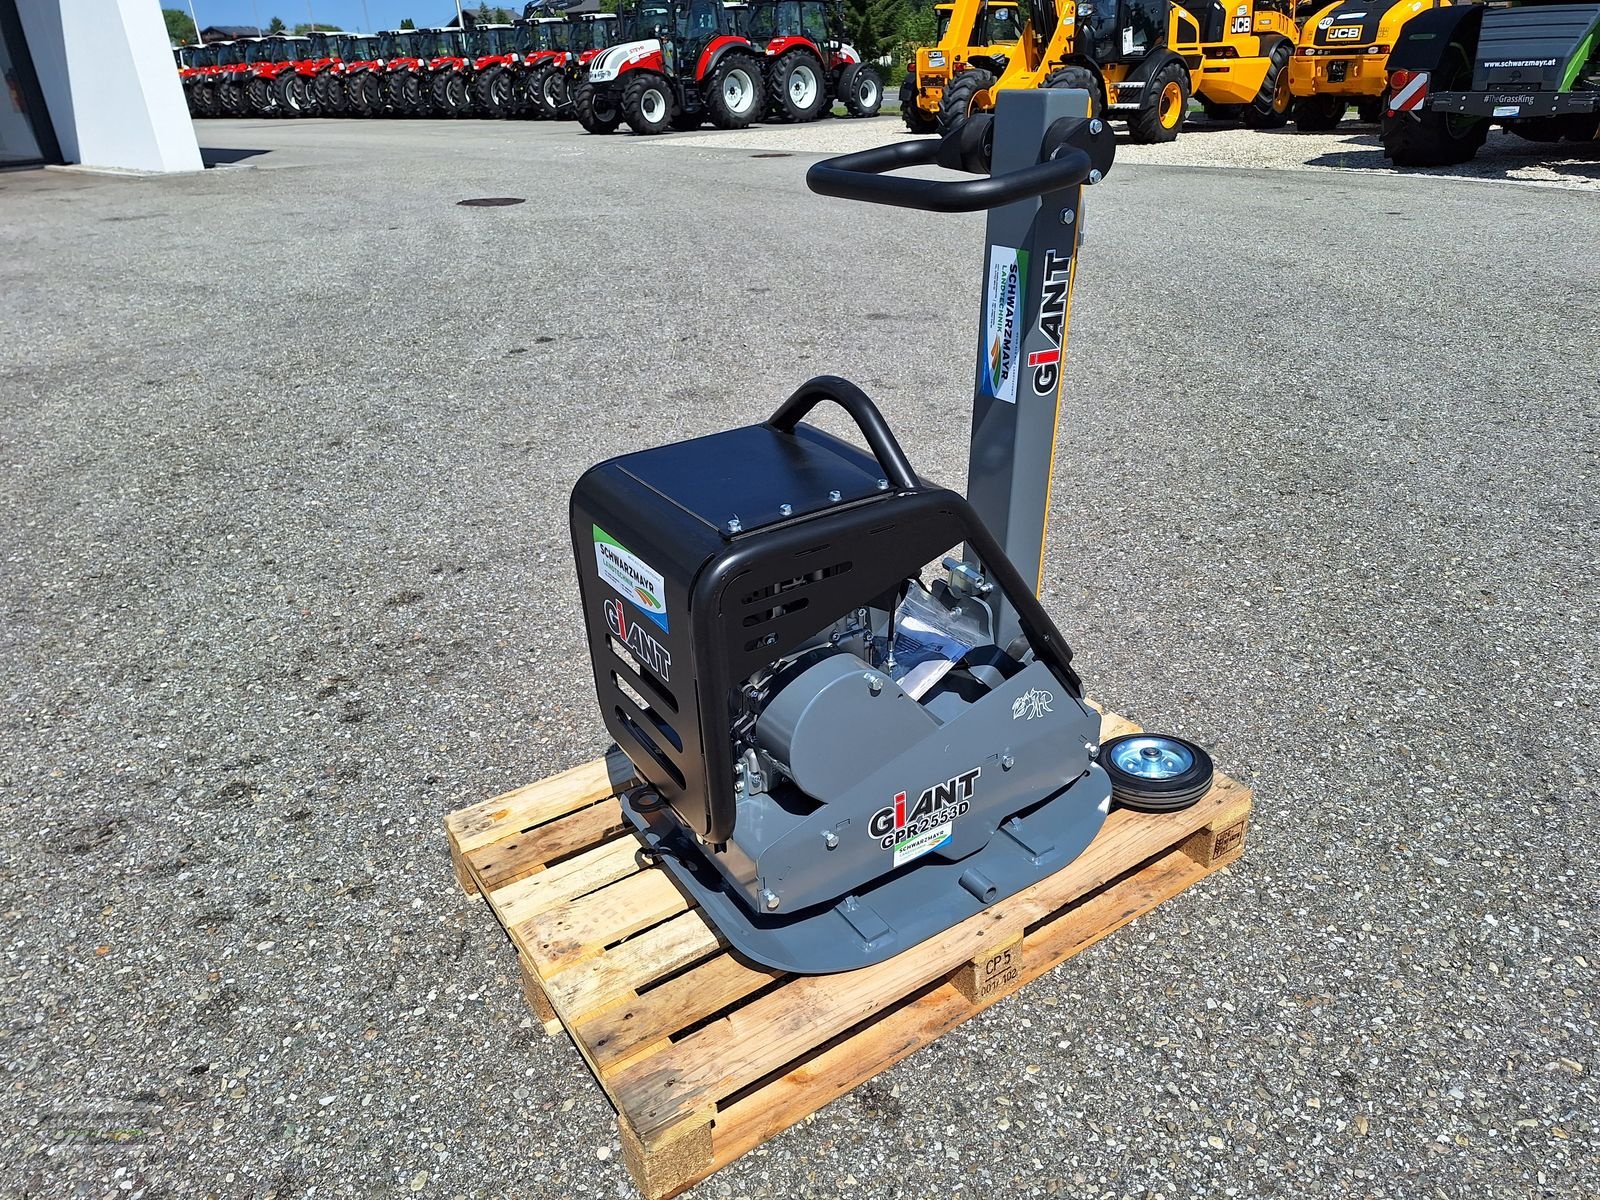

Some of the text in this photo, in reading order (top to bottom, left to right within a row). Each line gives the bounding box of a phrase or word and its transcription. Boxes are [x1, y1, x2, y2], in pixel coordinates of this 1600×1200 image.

[1231, 17, 1251, 33] JCB
[1319, 18, 1333, 26] 40
[1329, 28, 1359, 39] JCB
[1484, 58, 1556, 68] www.schwarzmayr.at
[1484, 95, 1535, 105] #TheGrassKing
[996, 265, 1008, 333] LANDTECHNIK
[1001, 263, 1018, 380] SCHWARZMAYR
[599, 543, 655, 595] SCHWARZMAYR
[881, 801, 970, 850] GPR2553D
[899, 830, 945, 854] SCHWARZMAYR
